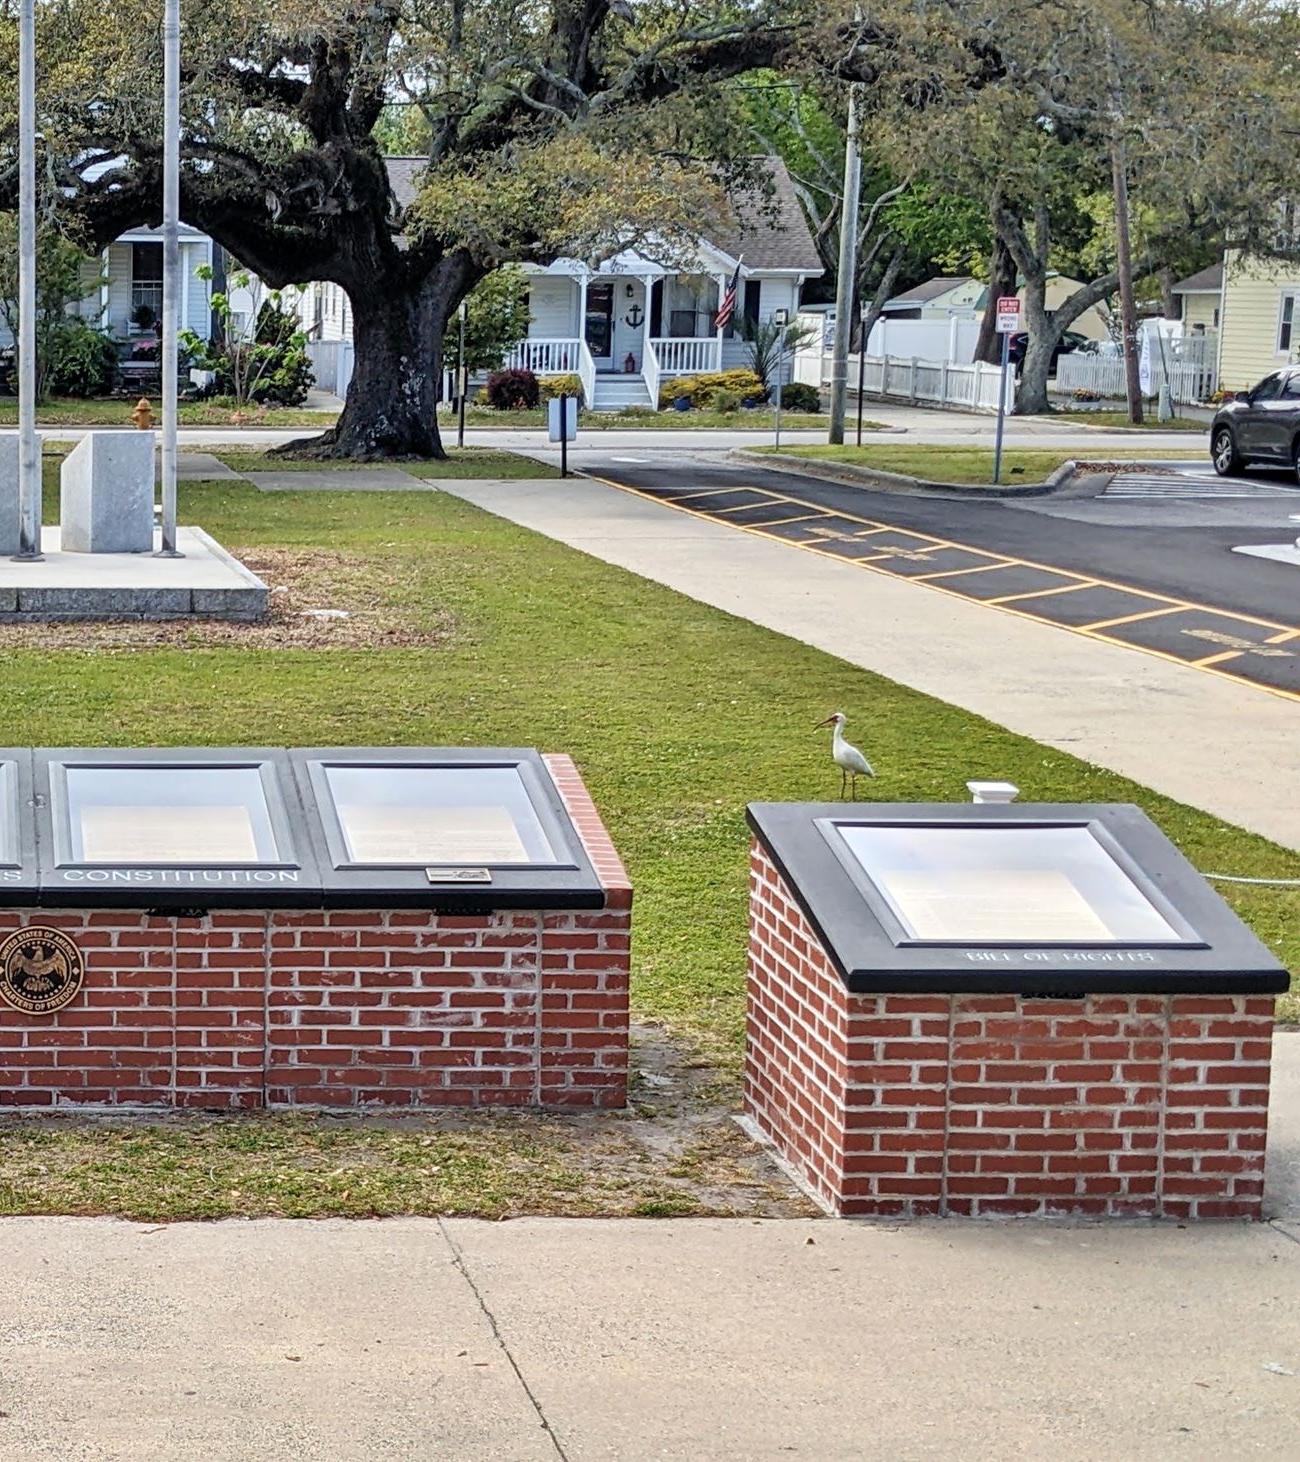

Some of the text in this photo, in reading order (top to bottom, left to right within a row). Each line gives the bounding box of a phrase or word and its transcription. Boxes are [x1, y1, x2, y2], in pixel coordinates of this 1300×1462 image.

[63, 870, 298, 882] CONSTITUTION
[0, 931, 77, 961] UNITED STATES OF AMERICA
[966, 952, 1154, 961] BILL OF RIGHTS
[0, 981, 77, 1011] CHARTERS OF FREEDOM
